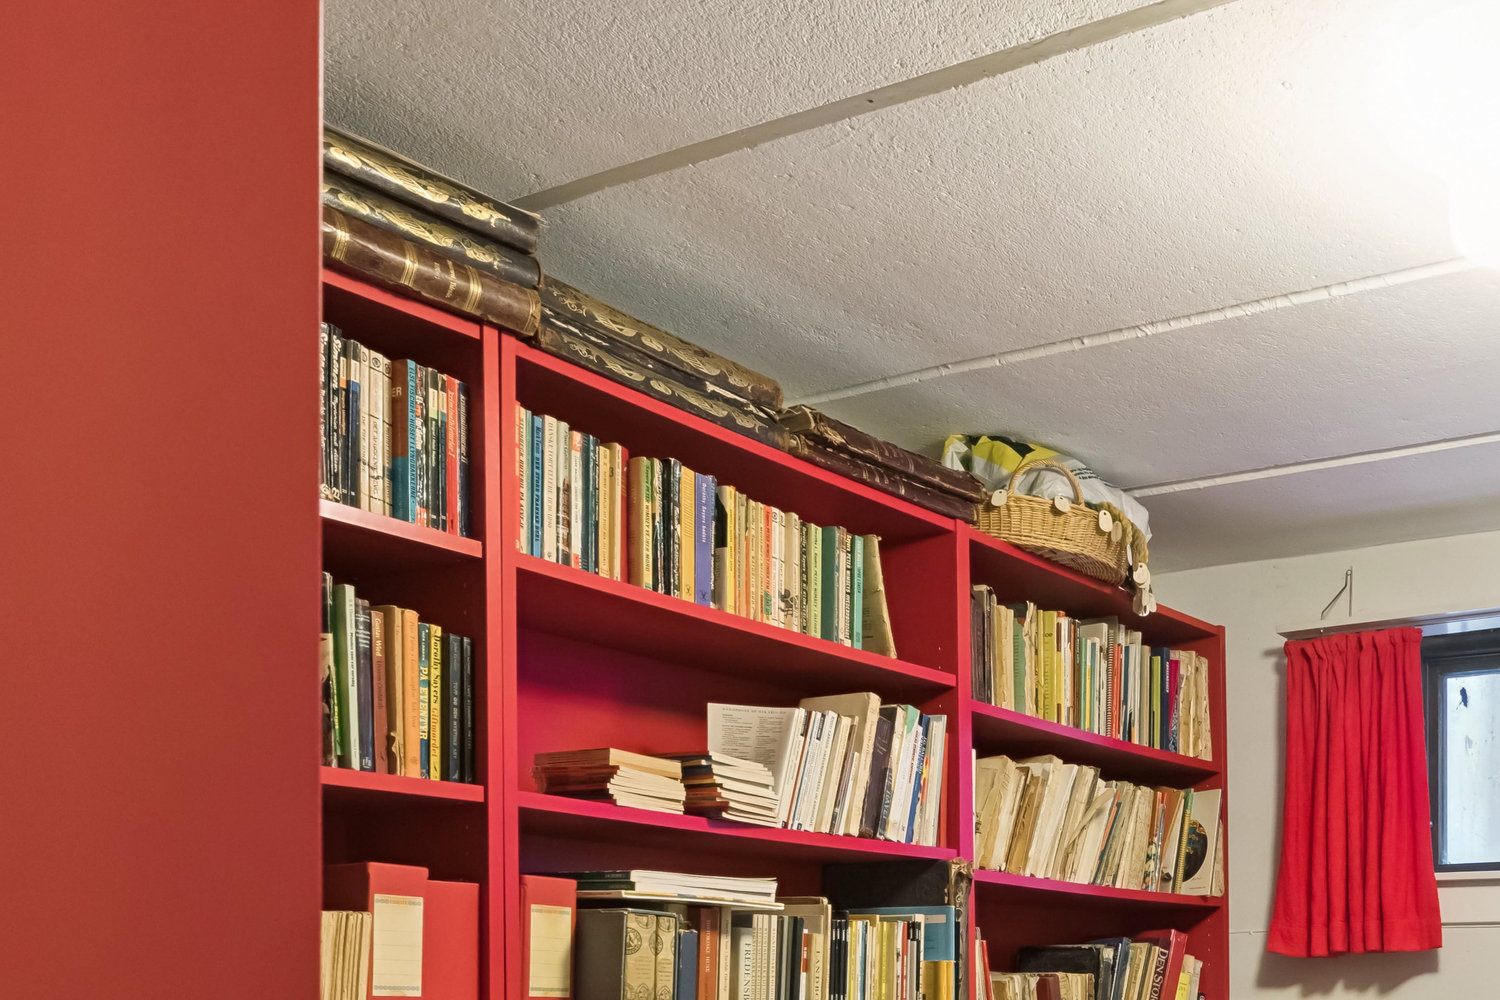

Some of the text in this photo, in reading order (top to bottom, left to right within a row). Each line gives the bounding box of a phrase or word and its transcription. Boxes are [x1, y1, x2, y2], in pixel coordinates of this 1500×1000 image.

[331, 335, 341, 389] Simenon
[374, 618, 382, 638] Gustav
[430, 634, 441, 670] Dorothy
[429, 673, 440, 704] Sayers
[419, 686, 428, 741] EVENTYR
[1156, 948, 1169, 973] DEN
